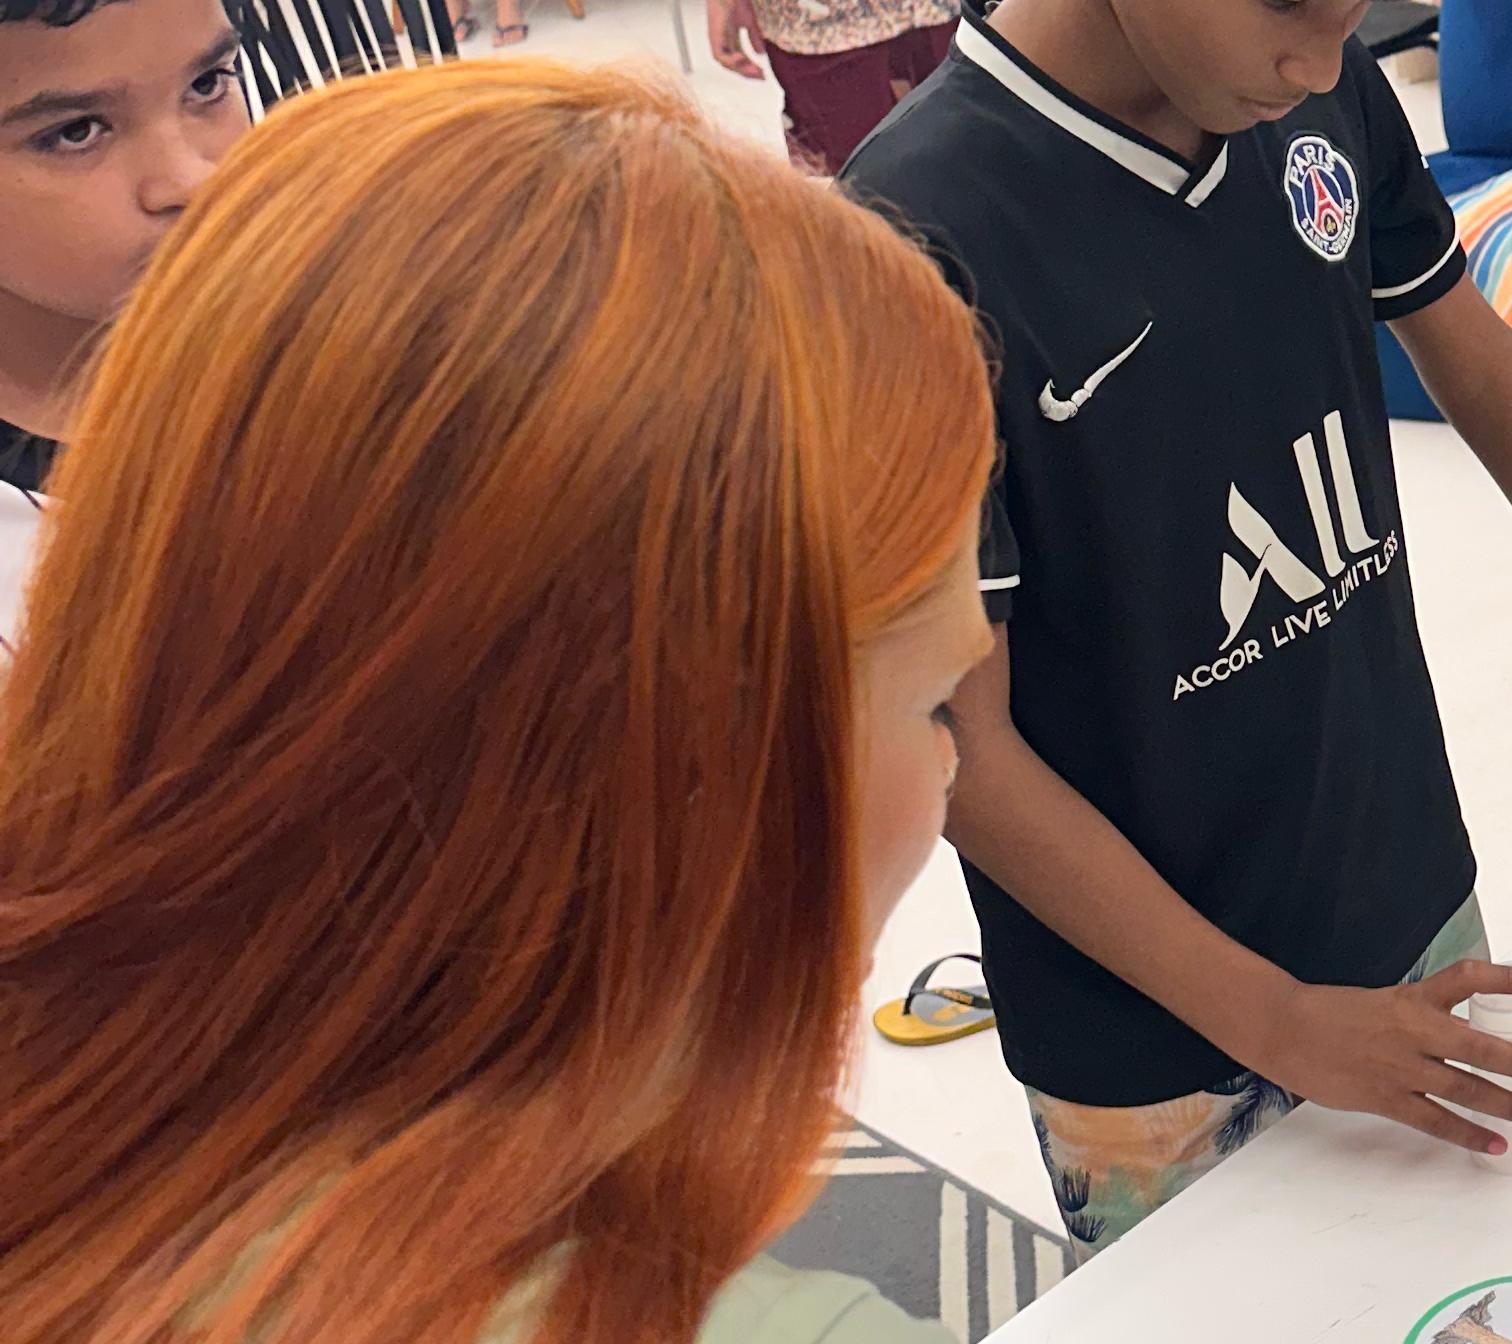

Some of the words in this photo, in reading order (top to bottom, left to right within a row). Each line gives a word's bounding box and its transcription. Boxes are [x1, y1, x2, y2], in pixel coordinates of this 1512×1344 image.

[1289, 143, 1337, 189] PARIS
[1172, 638, 1264, 701] ACCOR
[1270, 600, 1332, 649] LIVE
